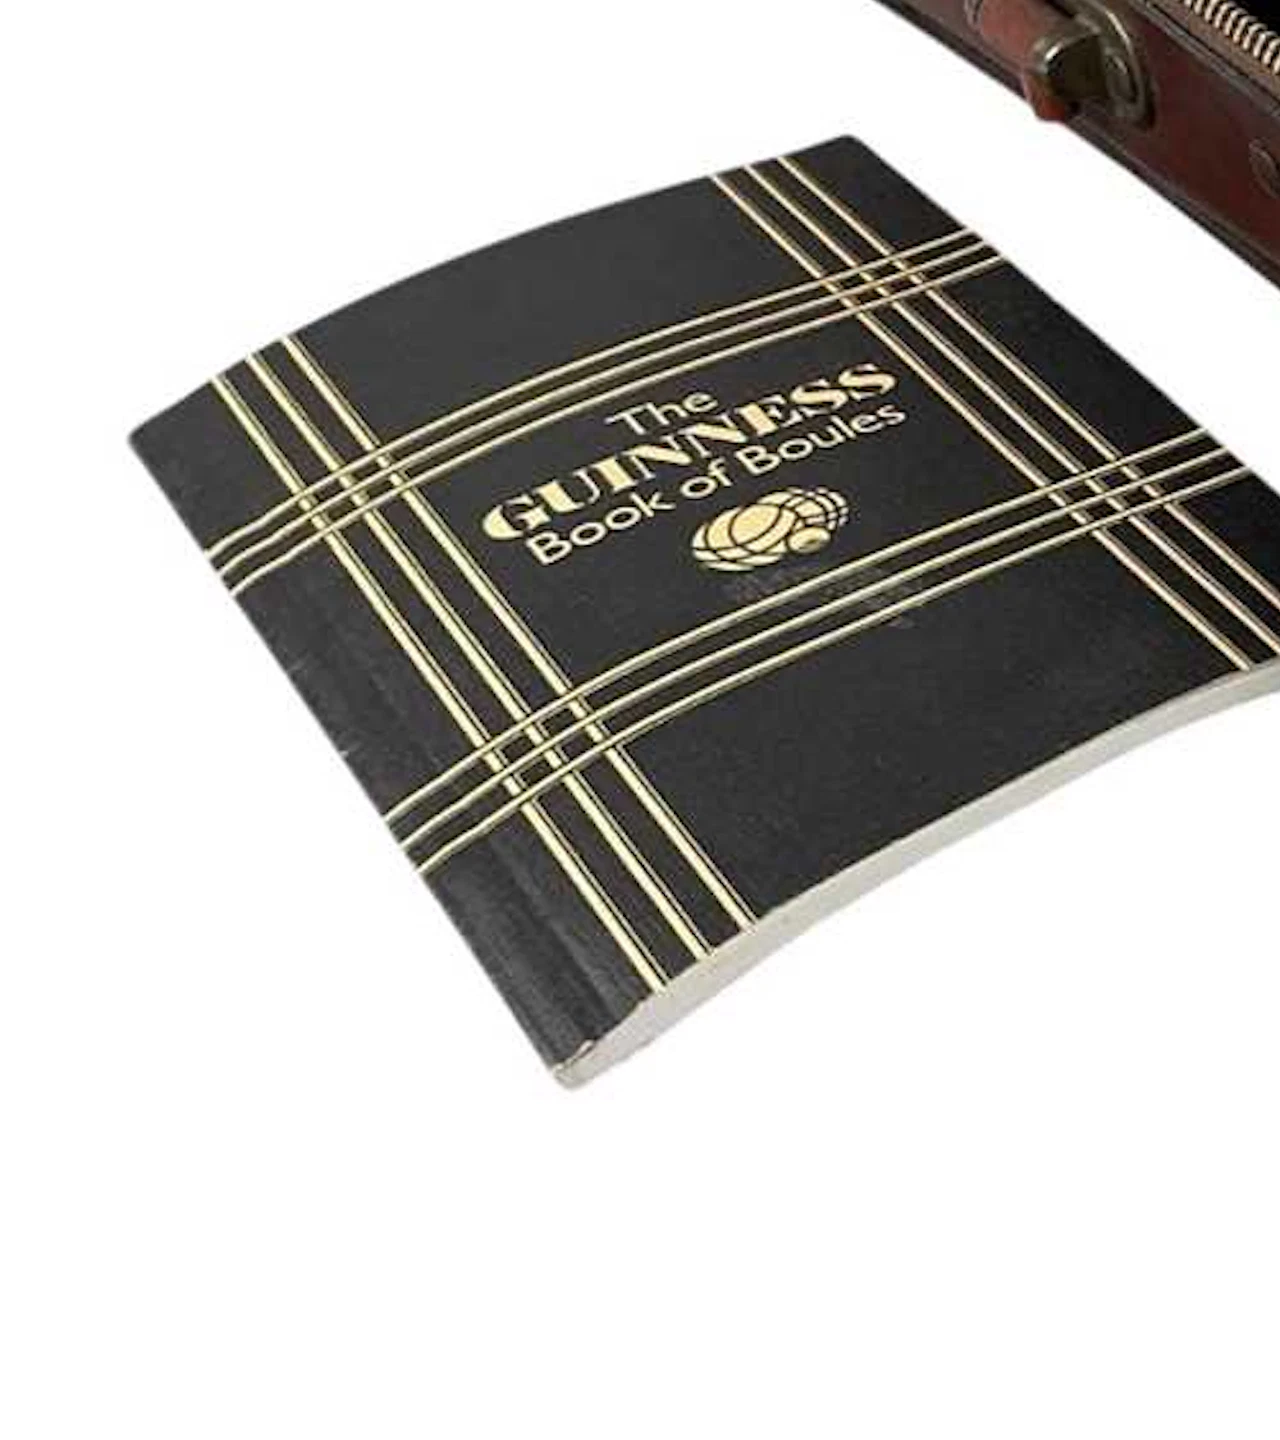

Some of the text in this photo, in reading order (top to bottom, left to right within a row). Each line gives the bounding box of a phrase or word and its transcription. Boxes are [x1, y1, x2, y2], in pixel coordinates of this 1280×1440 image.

[481, 363, 897, 542] GUINNESS
[525, 402, 907, 566] Book of Boules
[604, 389, 719, 436] The
